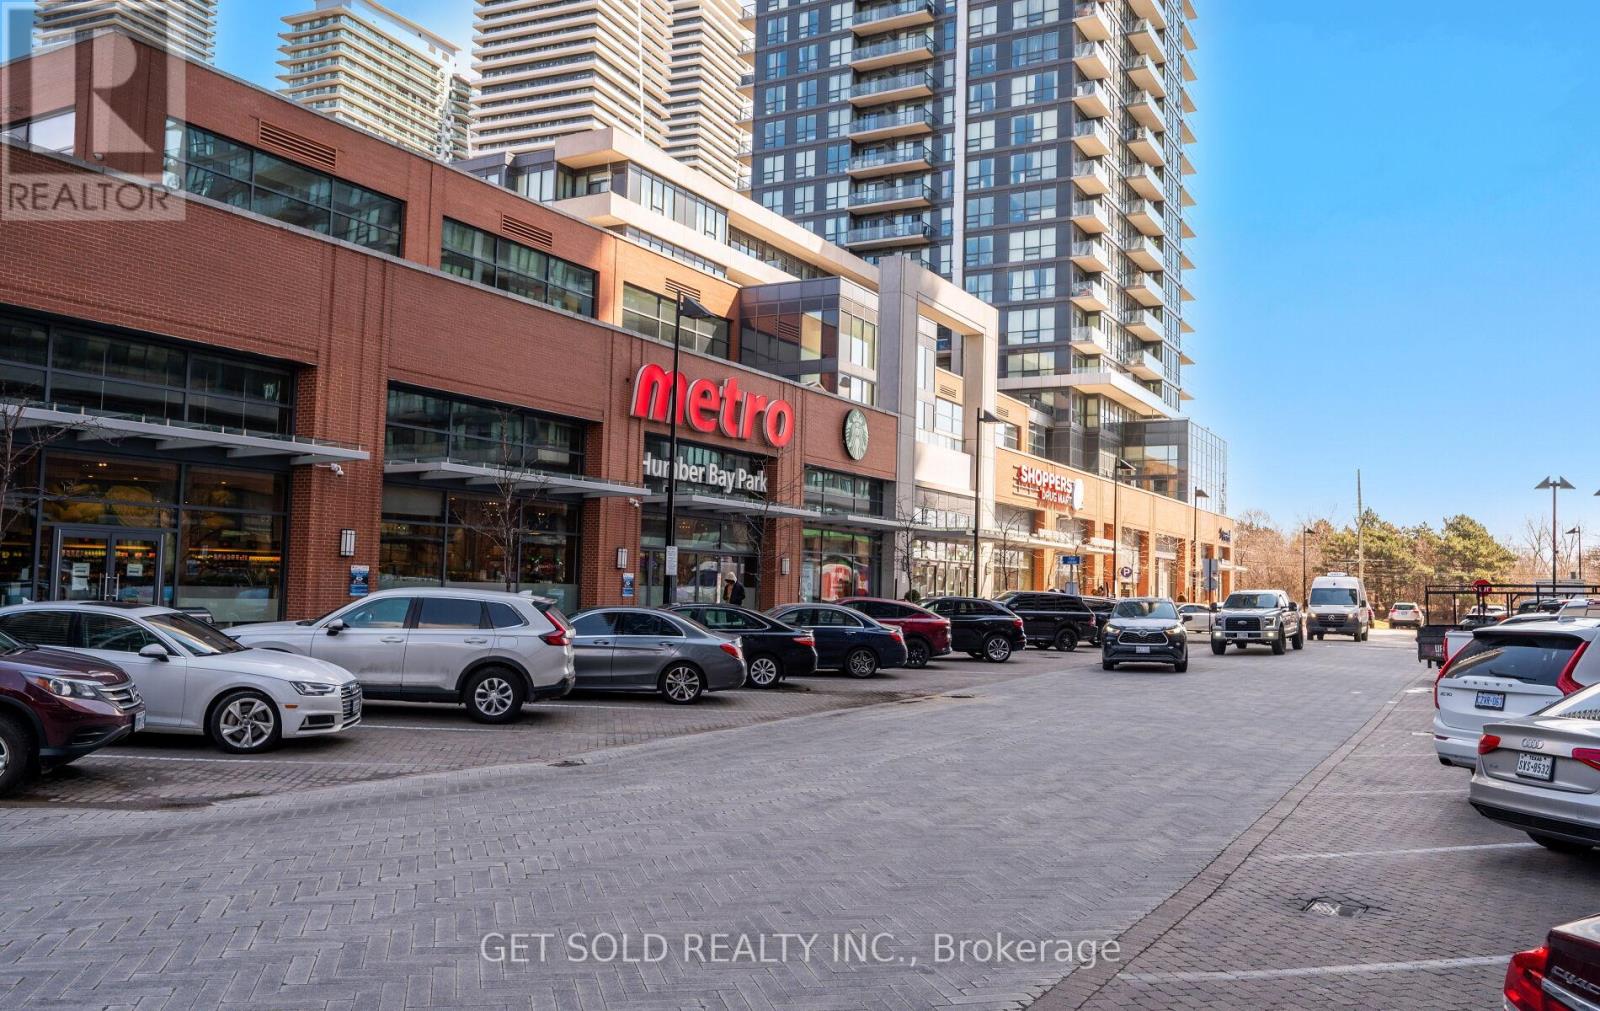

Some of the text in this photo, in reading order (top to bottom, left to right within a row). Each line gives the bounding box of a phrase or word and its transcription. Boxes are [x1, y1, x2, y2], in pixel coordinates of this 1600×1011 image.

[630, 362, 795, 449] metro
[643, 452, 768, 494] Humber Bay Park
[1019, 464, 1074, 494] SHOPPERS
[1040, 489, 1058, 503] DRUG
